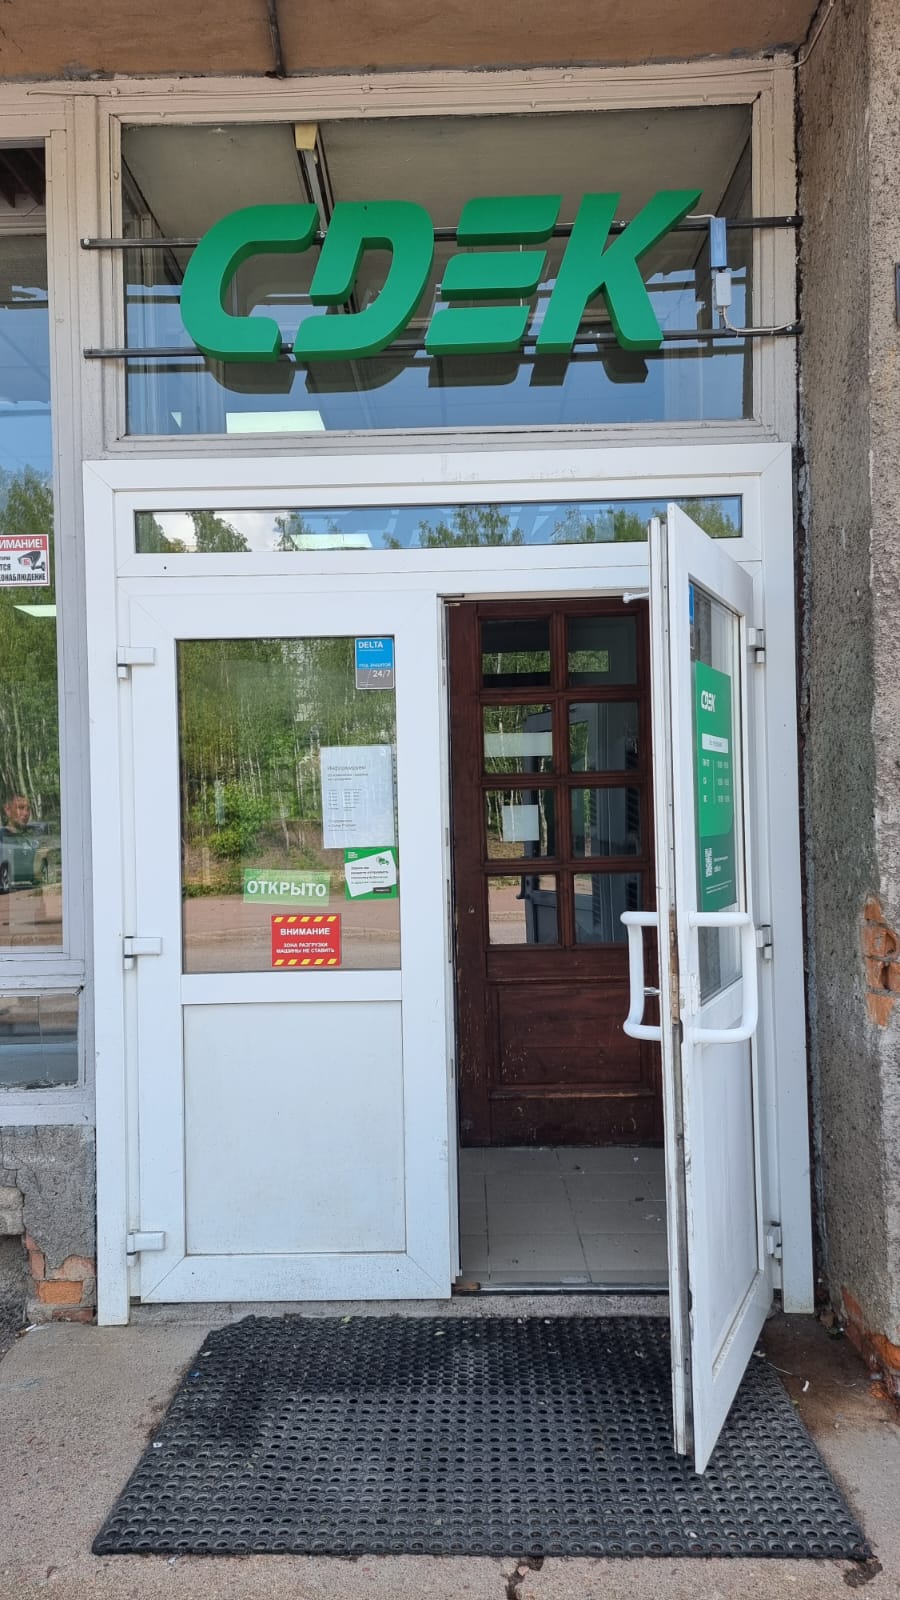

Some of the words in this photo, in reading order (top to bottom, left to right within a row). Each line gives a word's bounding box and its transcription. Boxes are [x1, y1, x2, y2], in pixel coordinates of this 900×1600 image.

[179, 189, 703, 362] CDEK
[0, 573, 46, 582] ОНАБЛЮДЕНИЕ
[358, 641, 384, 649] DELTA
[372, 669, 391, 678] 24/7
[246, 880, 327, 897] ОТКРЫТО
[280, 927, 331, 936] ВНИМАНИЕ
